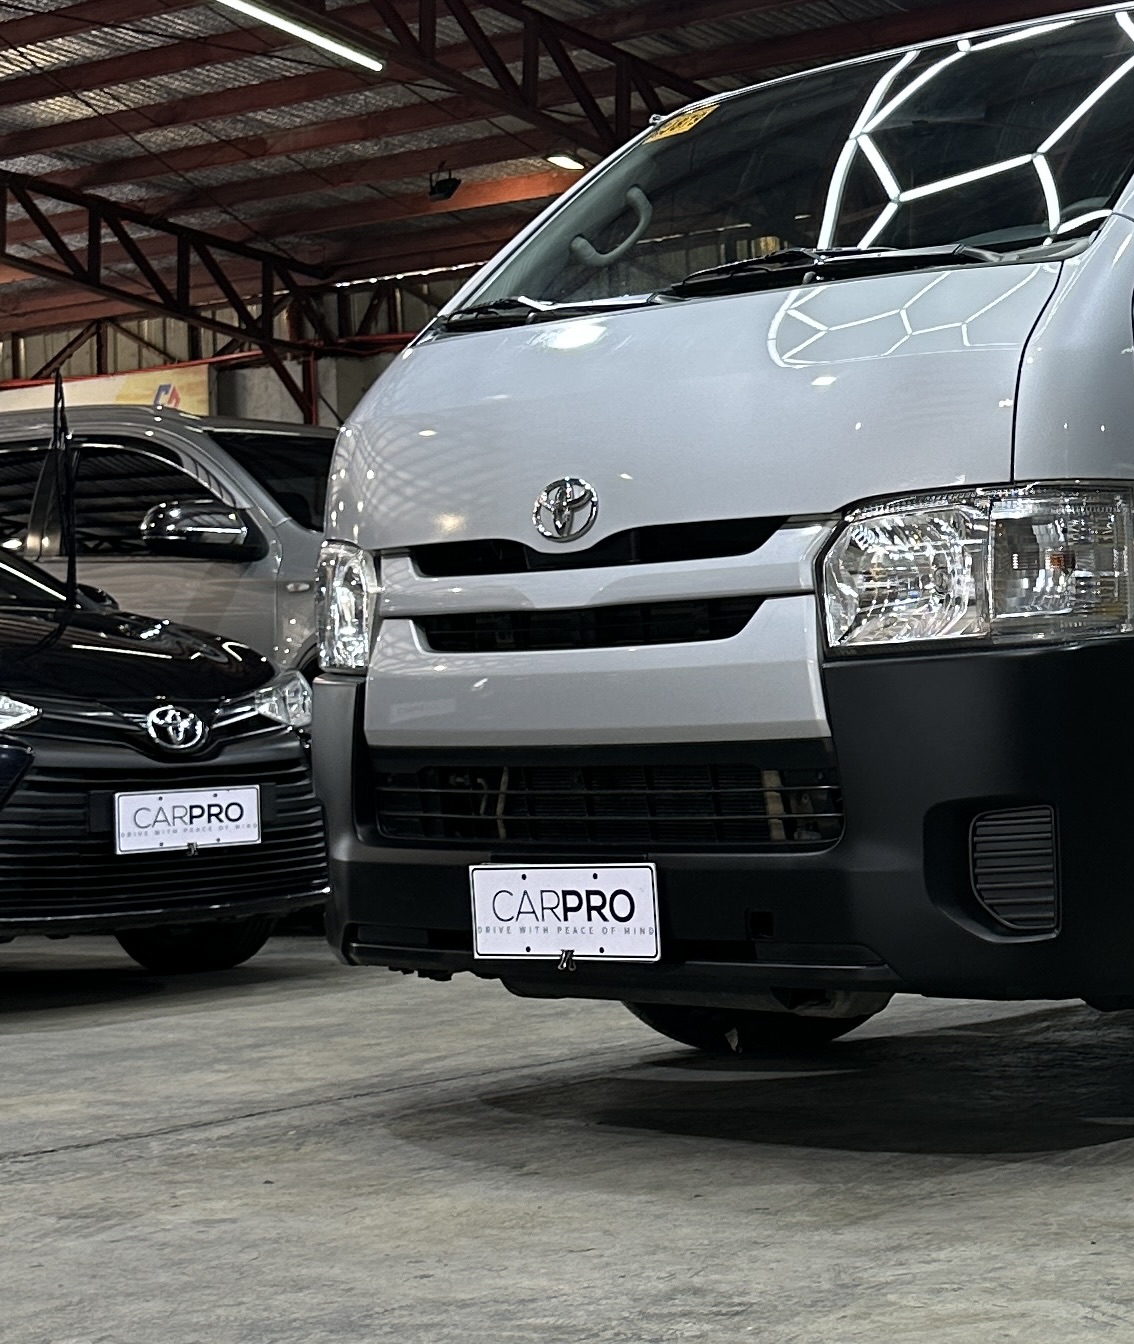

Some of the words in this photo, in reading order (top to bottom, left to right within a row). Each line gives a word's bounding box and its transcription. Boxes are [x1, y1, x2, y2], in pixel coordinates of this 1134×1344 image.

[133, 802, 244, 829] CARPRO
[492, 888, 636, 923] CARPRO
[478, 926, 512, 935] DRIVE
[519, 926, 549, 935] WITH
[557, 926, 594, 935] PEACE
[602, 926, 616, 935] OF
[624, 926, 655, 936] MIND
